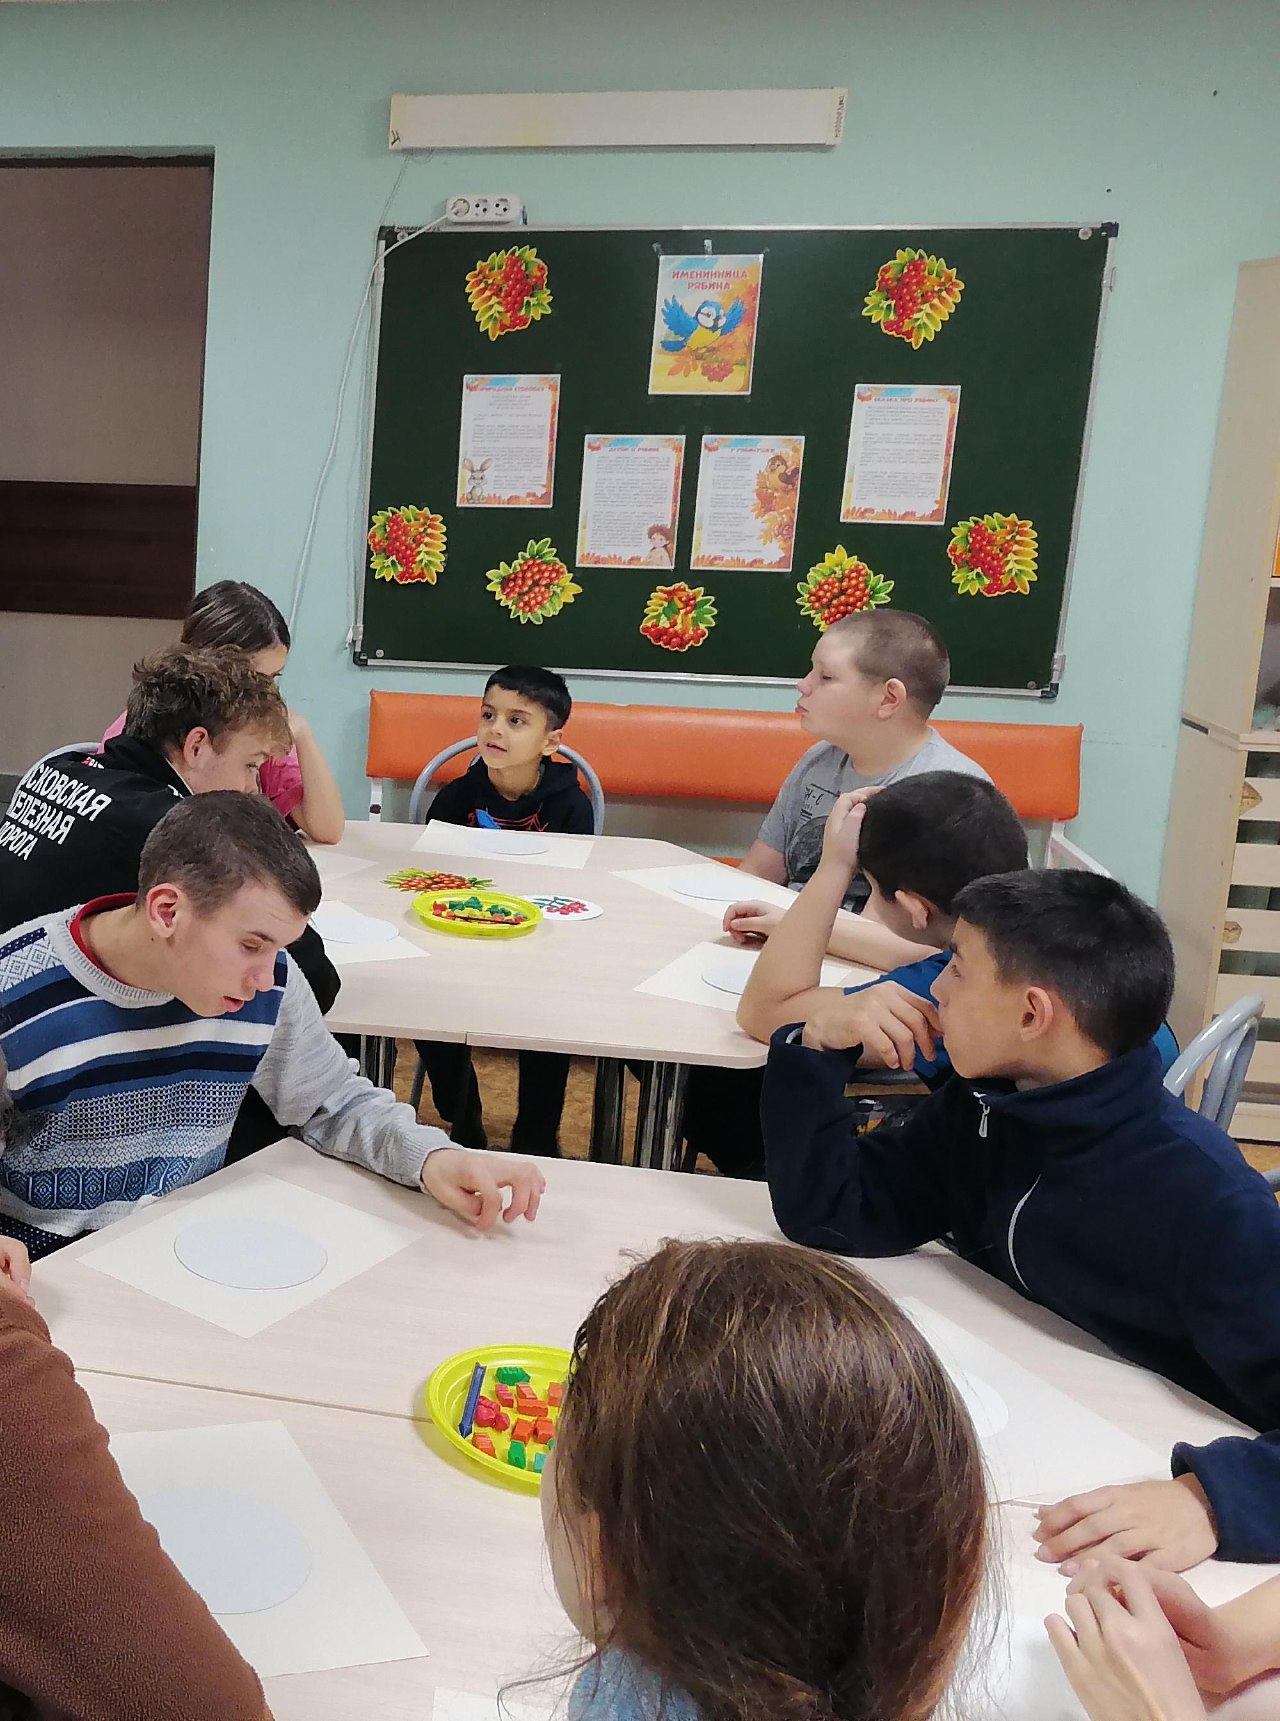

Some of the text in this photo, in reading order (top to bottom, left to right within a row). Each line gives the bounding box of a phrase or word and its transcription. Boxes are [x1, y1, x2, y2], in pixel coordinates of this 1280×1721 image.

[671, 270, 748, 280] ИМЕНИННИЦА
[687, 280, 731, 290] РЯБИНА
[23, 763, 112, 821] СКОВСКАЯ
